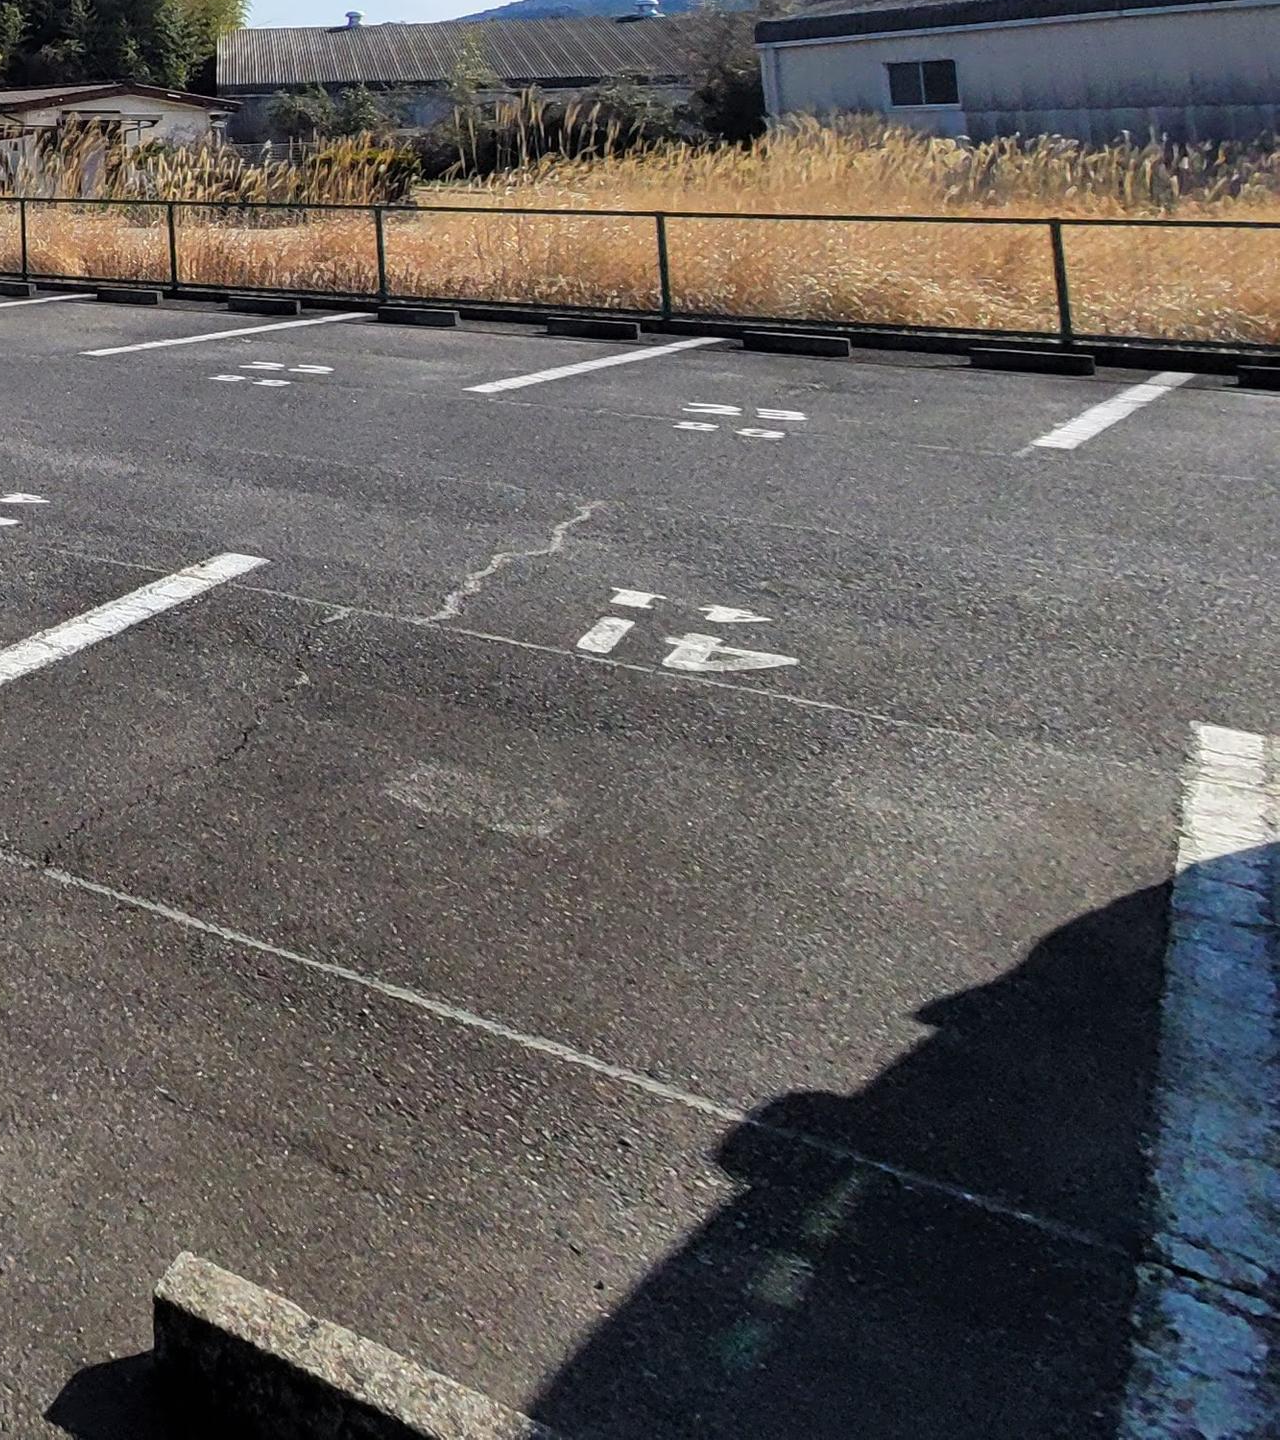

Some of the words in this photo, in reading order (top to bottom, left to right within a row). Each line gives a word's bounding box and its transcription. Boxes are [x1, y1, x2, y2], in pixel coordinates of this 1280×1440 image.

[238, 361, 335, 375] 22
[681, 402, 809, 421] 23
[576, 616, 800, 672] 41
